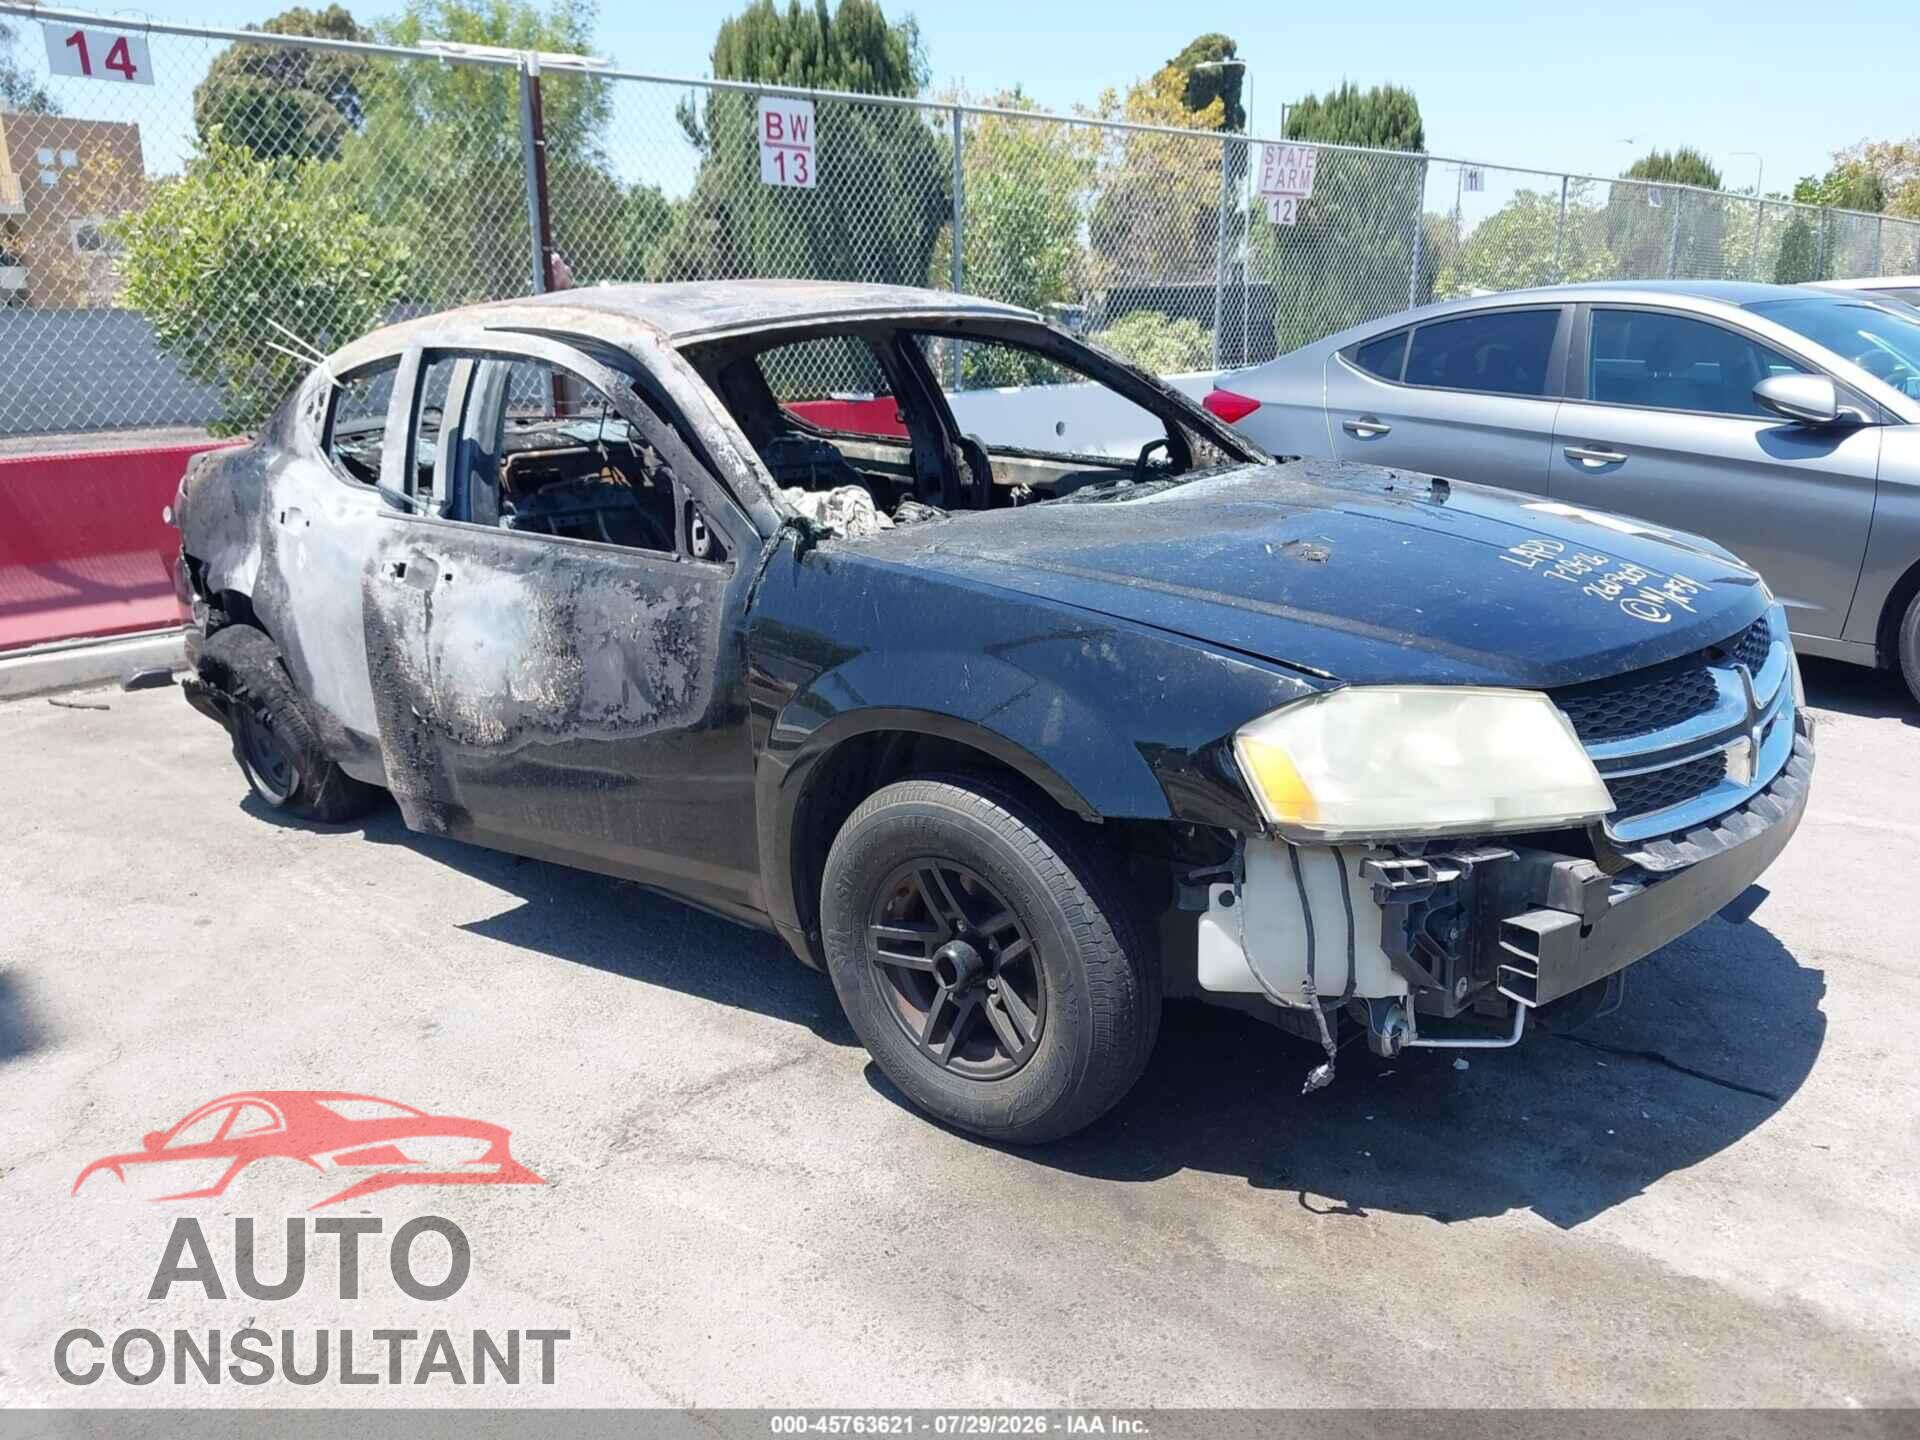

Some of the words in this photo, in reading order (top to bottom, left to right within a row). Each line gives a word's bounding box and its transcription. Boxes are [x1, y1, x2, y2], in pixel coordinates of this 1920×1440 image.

[65, 30, 137, 80] 14
[765, 111, 808, 142] BW
[773, 151, 808, 184] 13
[1264, 145, 1315, 168] STATE
[1263, 167, 1311, 190] FARM
[1272, 199, 1293, 222] 12
[1499, 539, 1565, 569] LAPD
